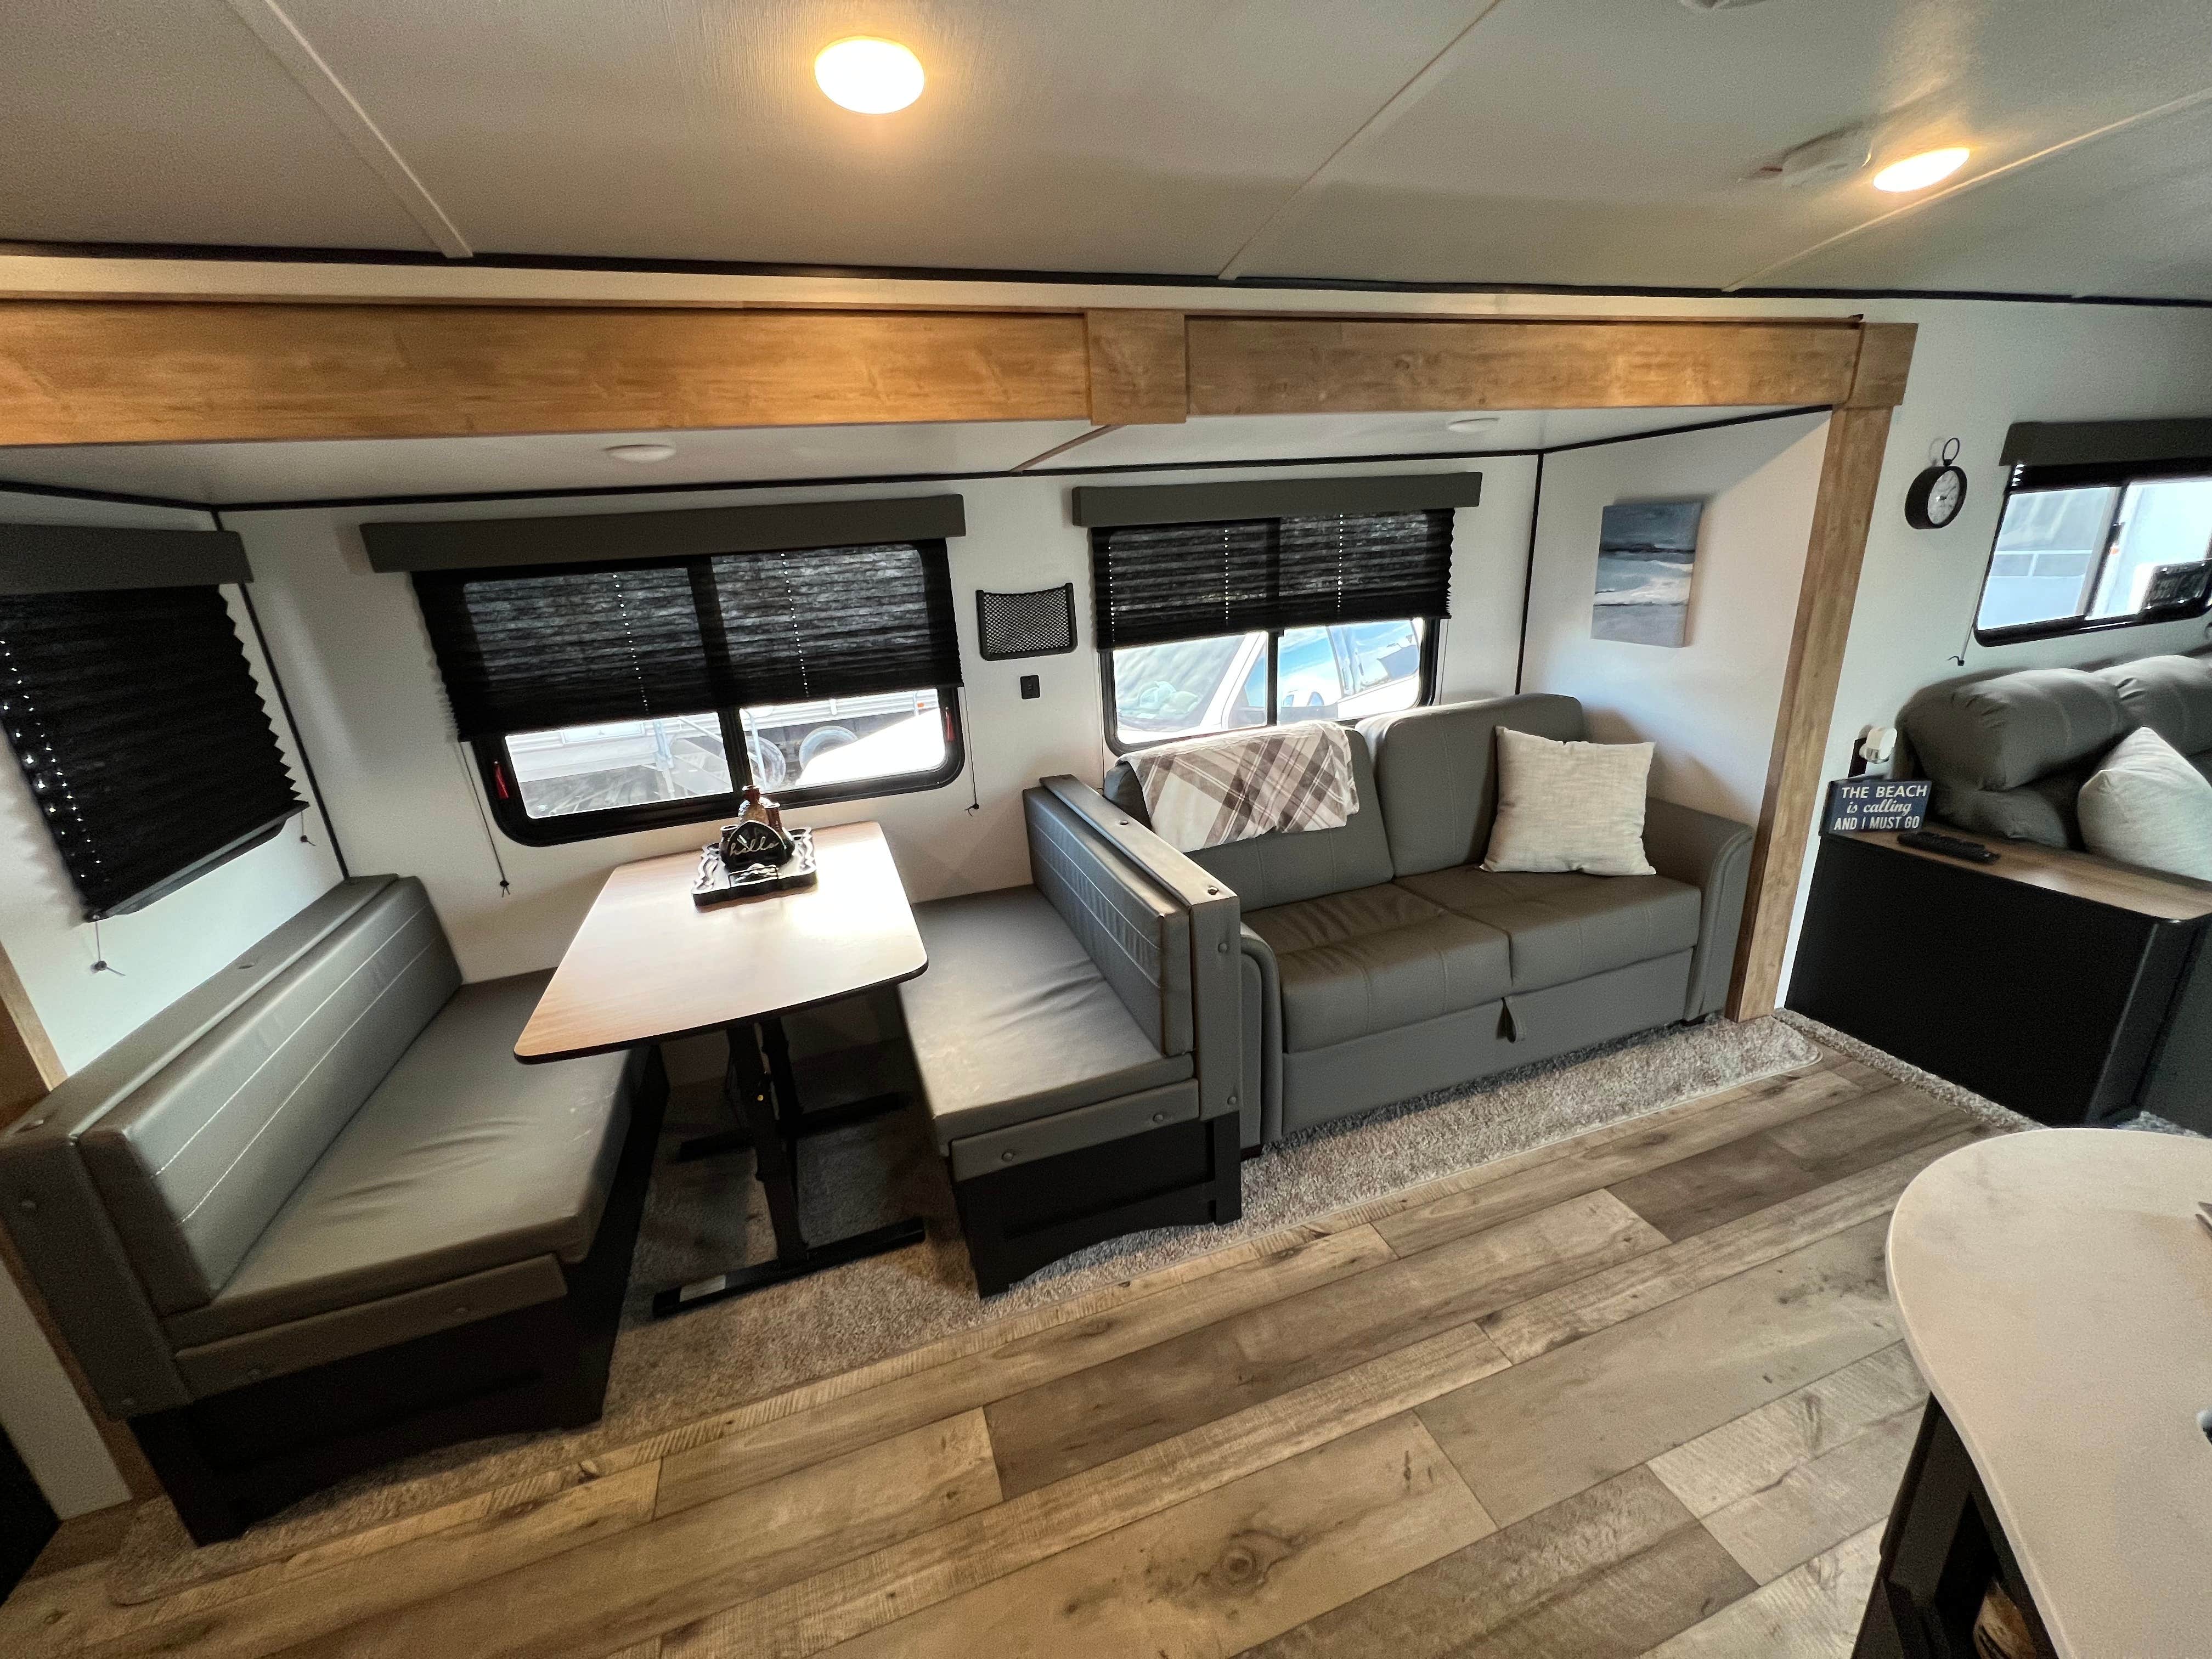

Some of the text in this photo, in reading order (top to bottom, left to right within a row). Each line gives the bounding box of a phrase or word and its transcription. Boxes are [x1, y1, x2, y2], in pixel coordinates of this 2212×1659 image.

[1842, 785, 1927, 799] THE BEACH
[1847, 799, 1912, 816] is calling
[1834, 815, 1920, 830] AND I MUST GO
[730, 836, 779, 856] hello
